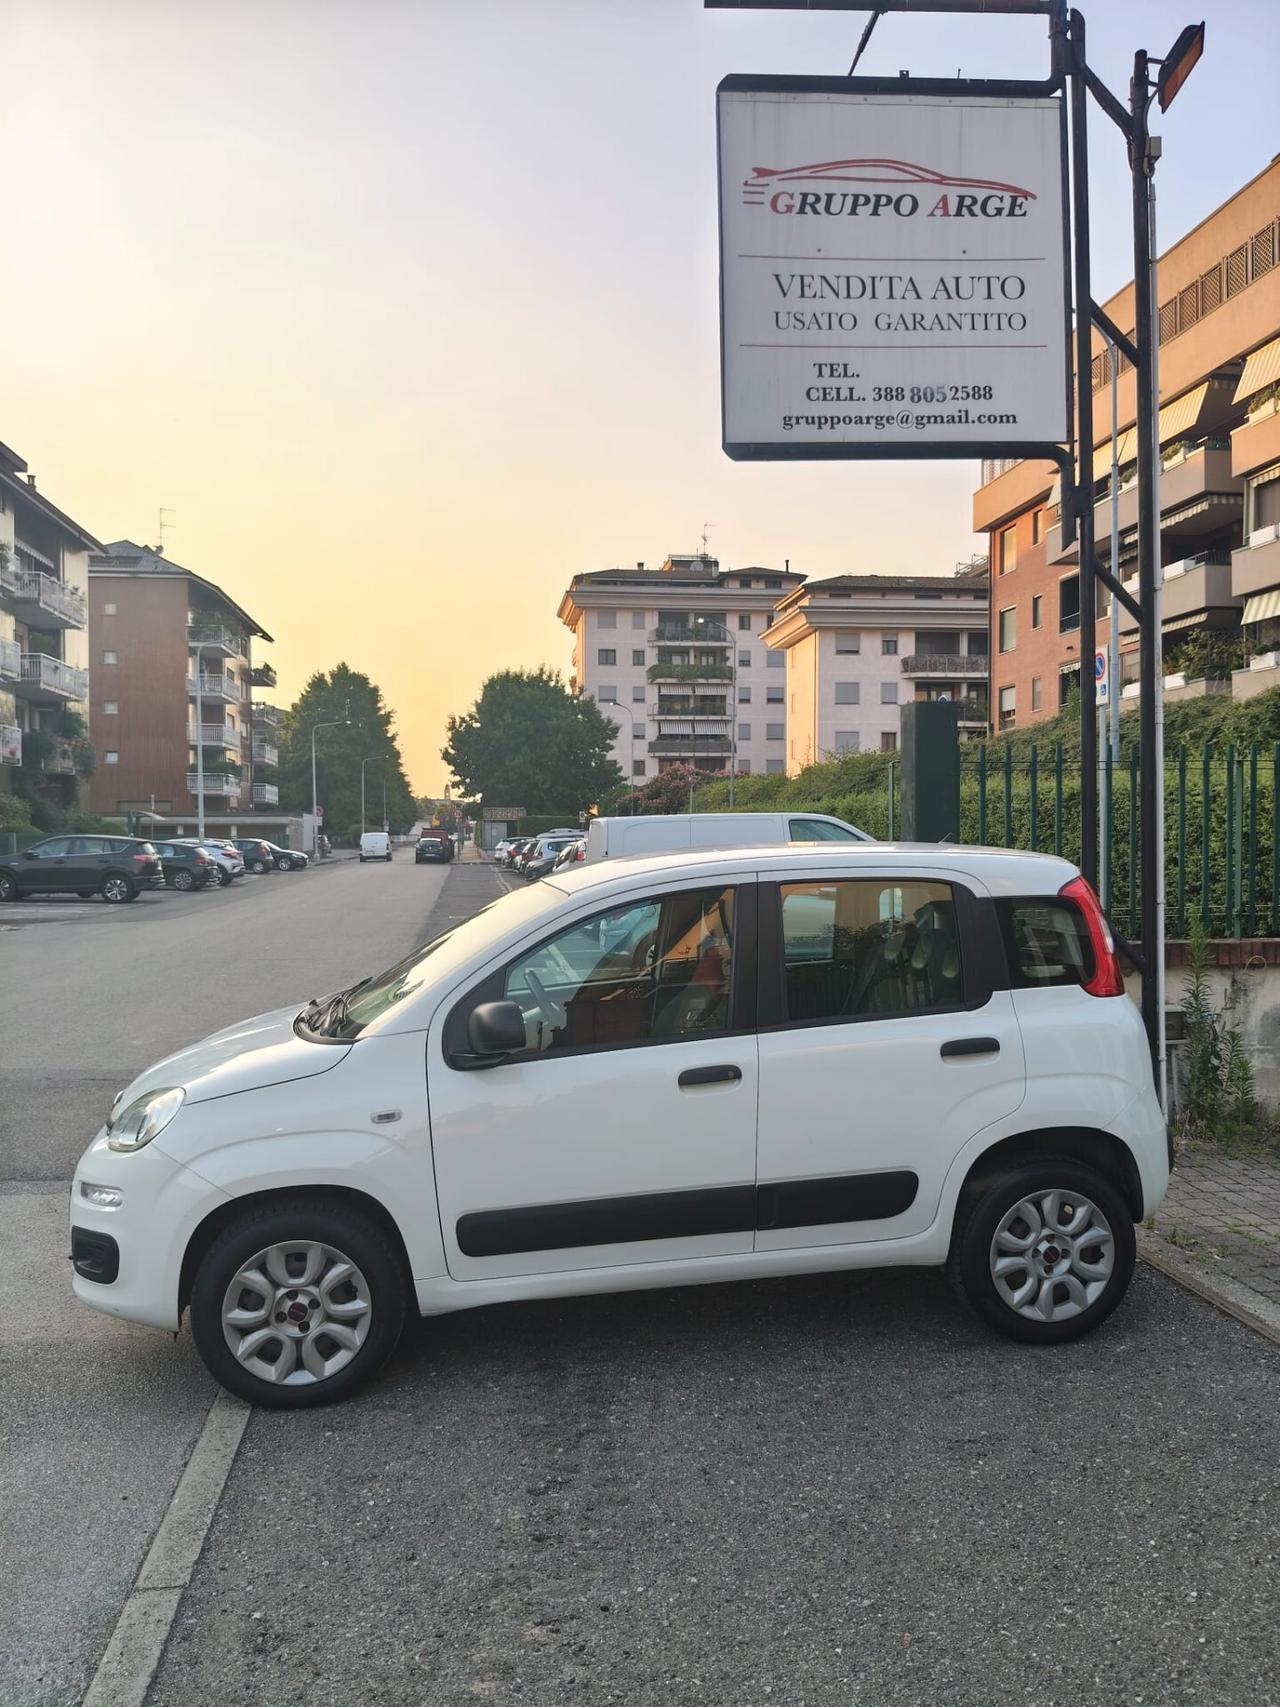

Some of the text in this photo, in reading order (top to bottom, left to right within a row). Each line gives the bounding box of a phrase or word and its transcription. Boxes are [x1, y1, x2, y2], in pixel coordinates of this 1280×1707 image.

[770, 191, 1028, 218] GRUPPO ARGE
[772, 273, 1026, 301] VENDITA AUTO
[774, 311, 1027, 332] USATO GARANTITO
[813, 362, 861, 379] TEL.
[806, 386, 867, 402] CELL.
[872, 386, 906, 402] 388
[783, 409, 1018, 431] gruppoarge@gmail.com
